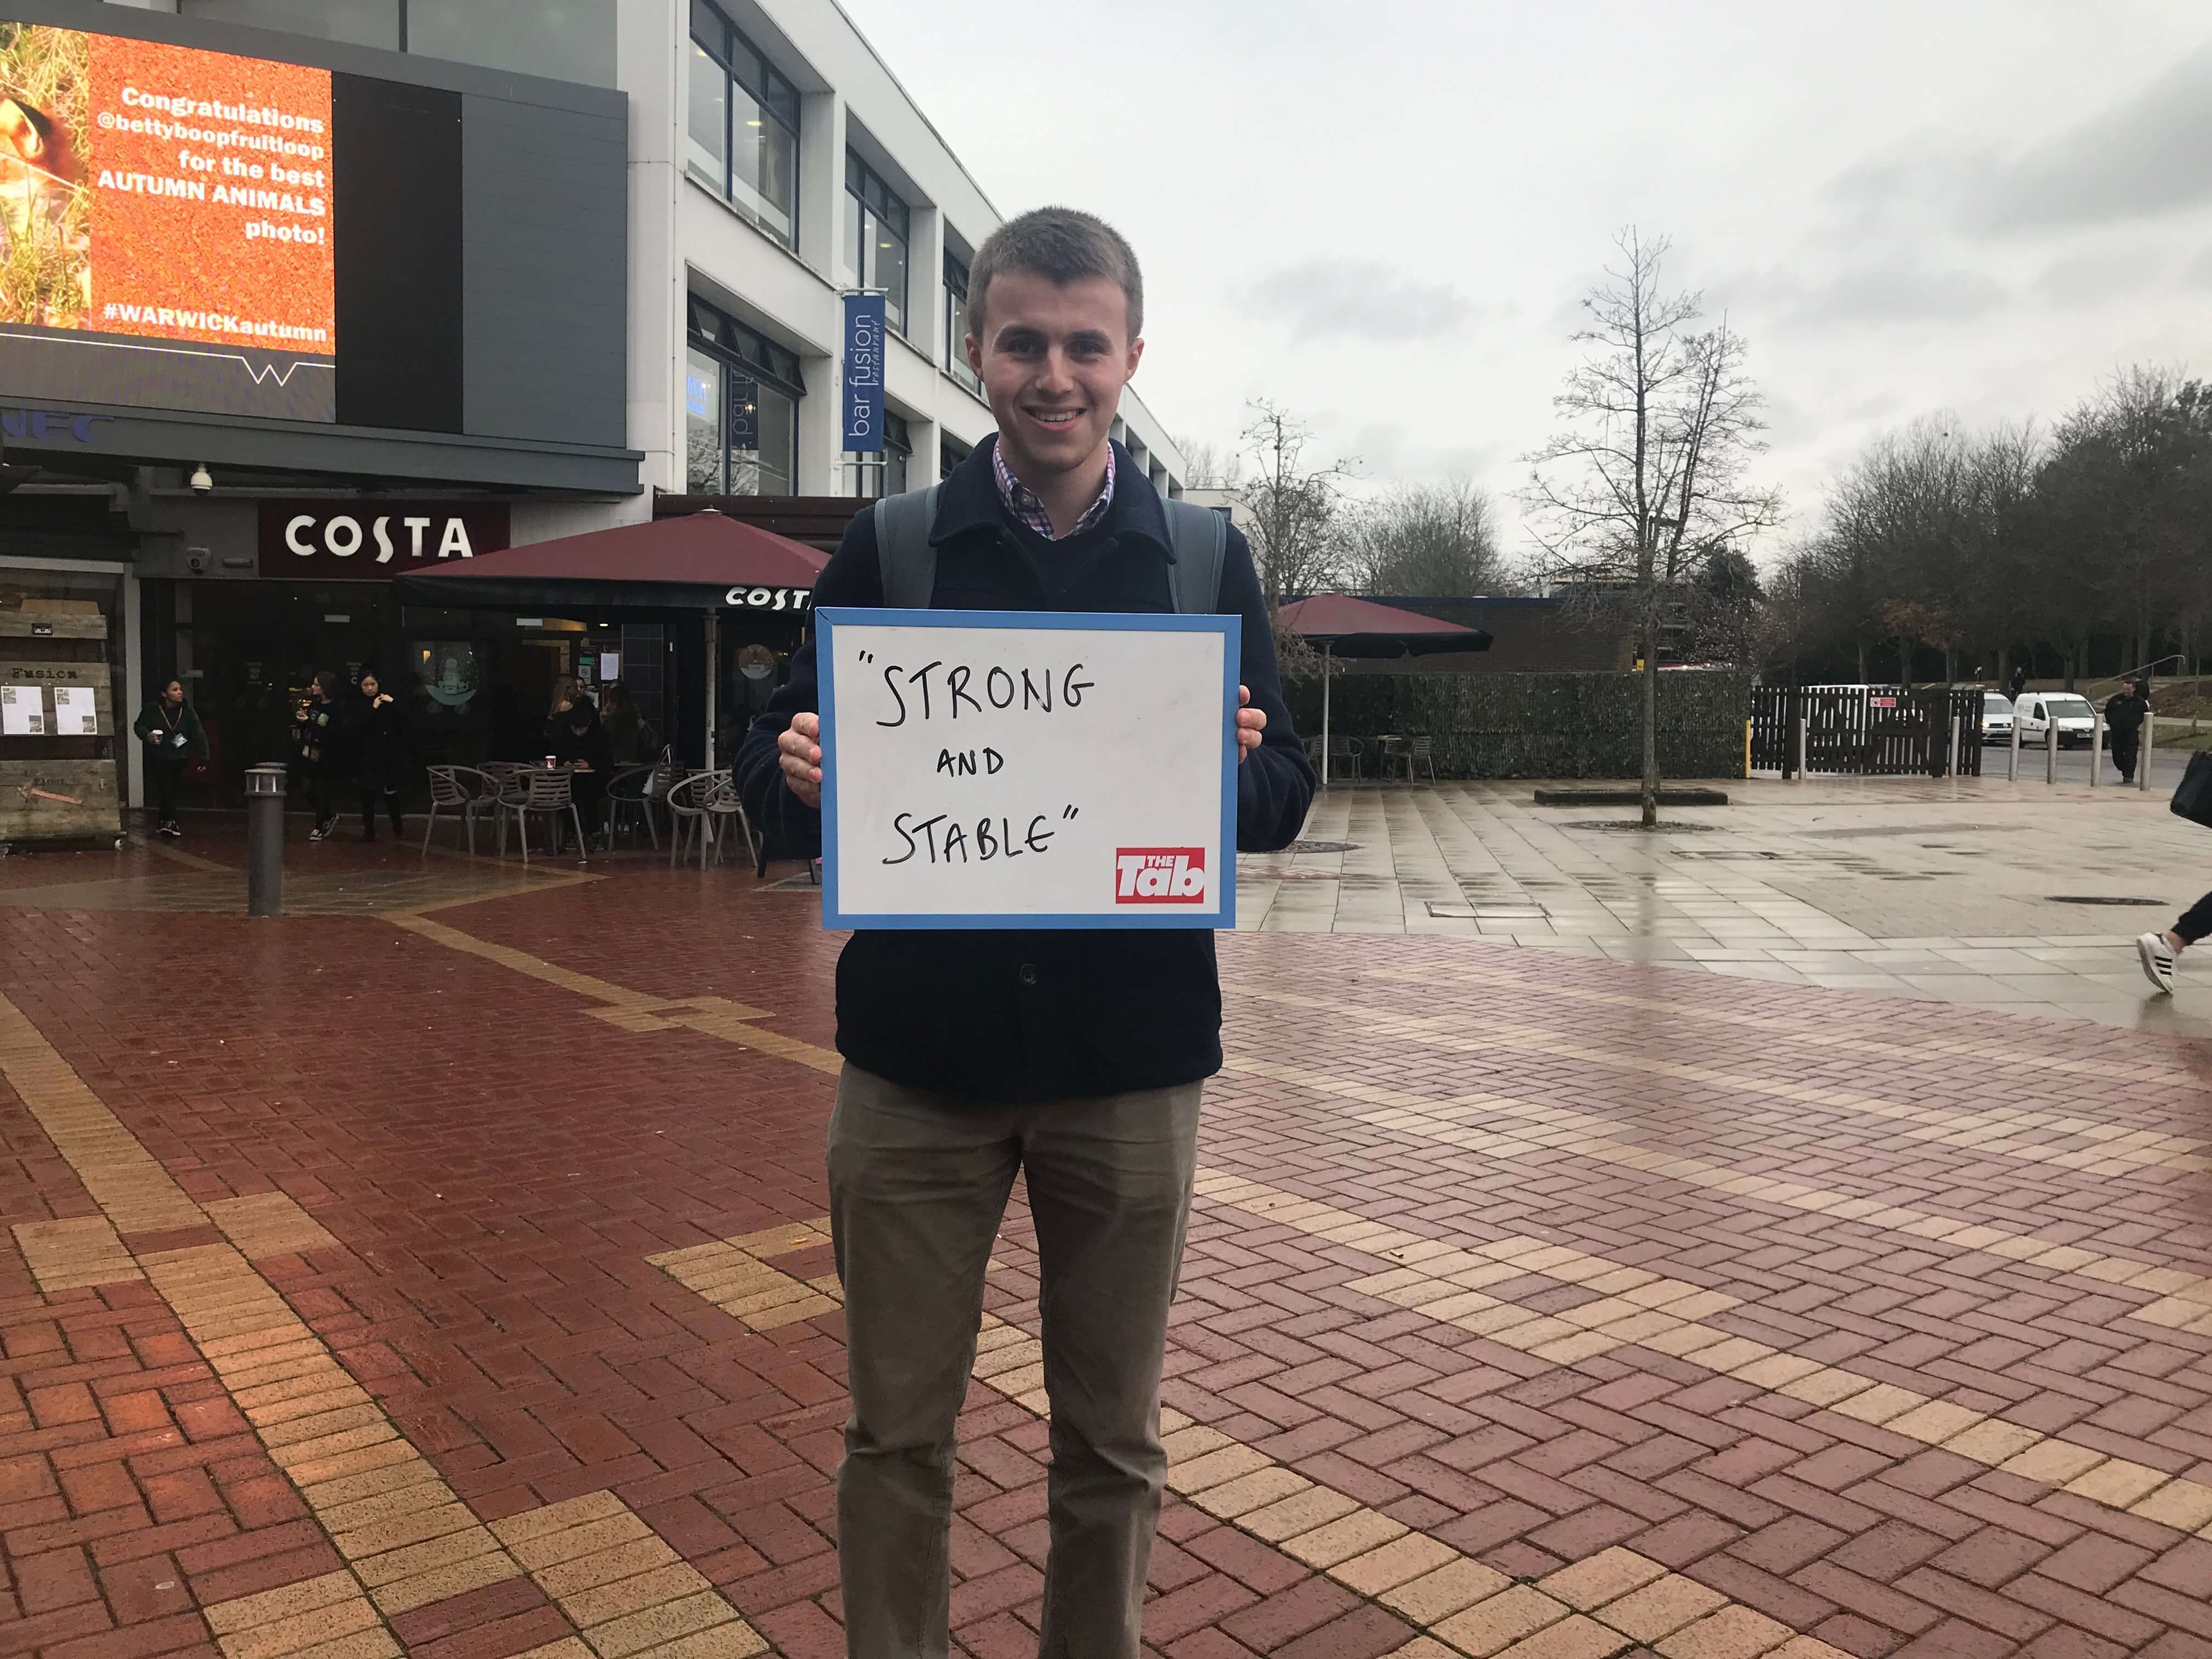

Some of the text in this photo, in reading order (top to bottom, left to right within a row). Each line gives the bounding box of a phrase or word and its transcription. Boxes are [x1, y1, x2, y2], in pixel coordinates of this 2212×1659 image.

[122, 87, 325, 134] Congratulations
[97, 111, 324, 161] @bettyboopfruitloop
[178, 150, 325, 188] for the best
[98, 170, 325, 217] AUTUMN ANIMALS
[245, 220, 325, 245] photo!
[103, 302, 326, 342] #WARWICKautumn
[871, 319, 880, 383] restaurant
[848, 315, 879, 436] bar fusion
[285, 515, 473, 563] COSTA
[725, 586, 812, 611] COST
[936, 748, 1004, 777] AND
[1116, 855, 1205, 897] Tab
[1147, 855, 1175, 867] THE
